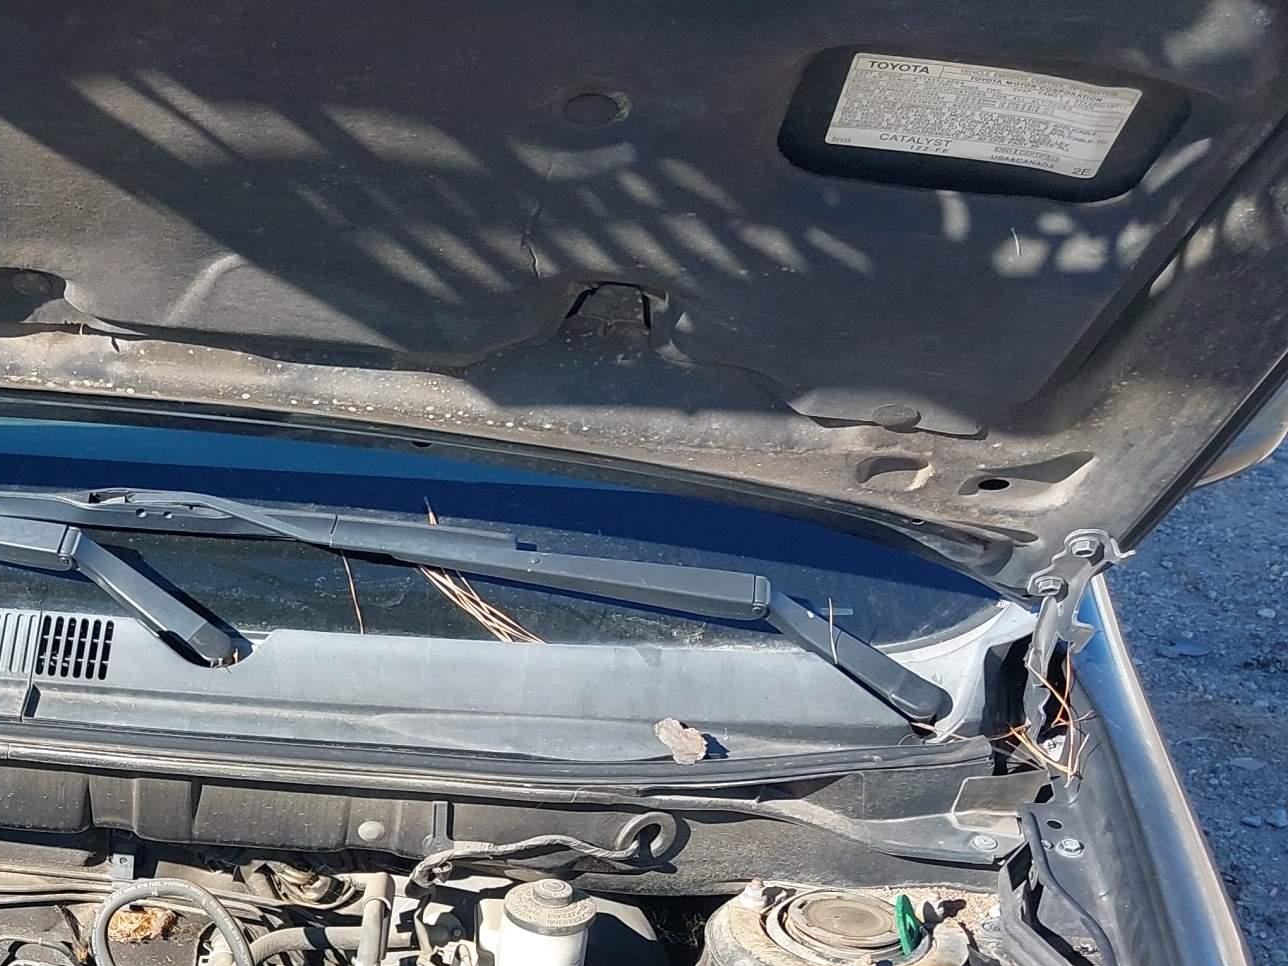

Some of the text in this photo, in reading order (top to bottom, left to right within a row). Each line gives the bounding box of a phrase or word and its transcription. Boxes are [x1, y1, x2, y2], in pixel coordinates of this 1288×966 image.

[868, 61, 930, 75] TOYOTA
[970, 76, 1002, 86] TOYOTA
[1005, 81, 1037, 90] MOTOR
[1039, 85, 1104, 103] CORPORATION
[879, 133, 953, 147] CATALYST
[1072, 167, 1092, 176] 2E
